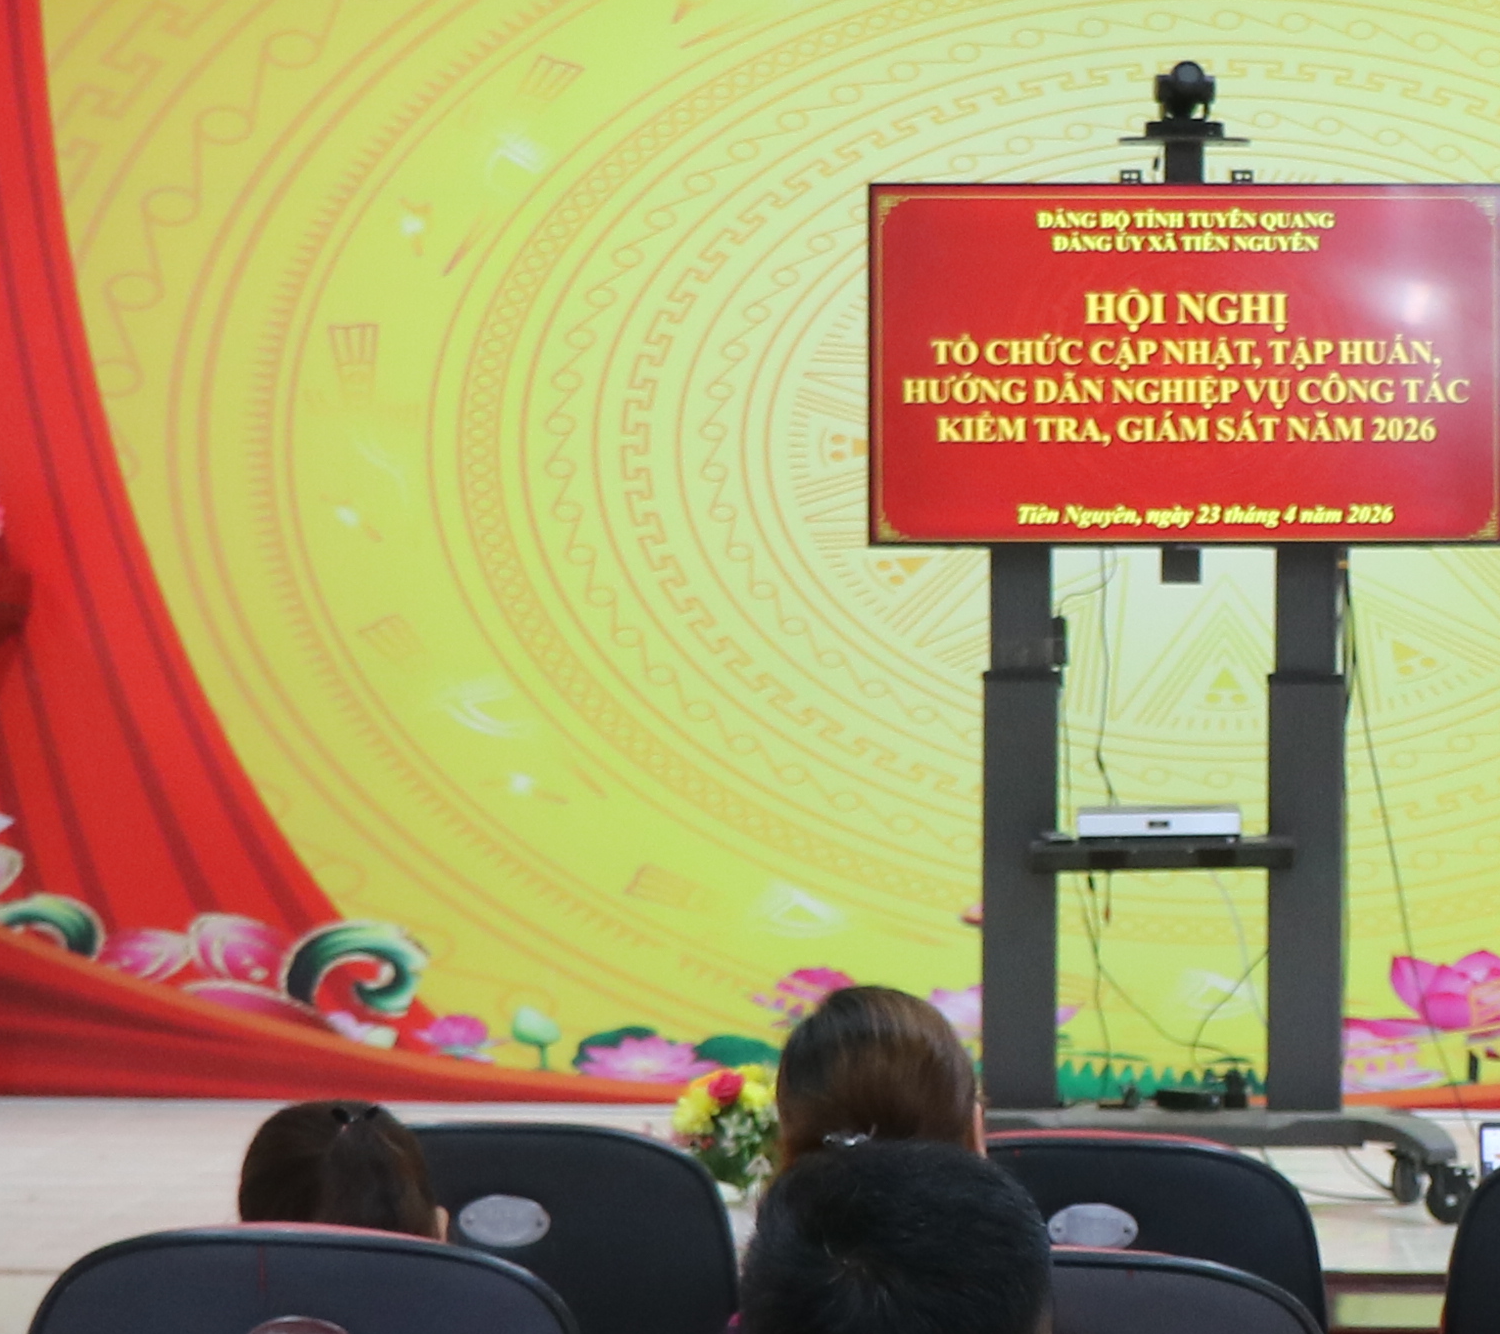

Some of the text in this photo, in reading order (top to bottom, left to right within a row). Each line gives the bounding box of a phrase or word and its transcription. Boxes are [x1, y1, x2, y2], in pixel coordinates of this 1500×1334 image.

[1037, 209, 1335, 231] ĐẢNG BỘ TỈNH TUYÊN QUANG
[1051, 232, 1320, 252] ĐẢNG ỦY XÃ TIÊN NGUYÊN
[1084, 289, 1289, 333] HỘI NGHỊ
[930, 333, 1442, 372] TỔ CHỨC CẬP NHẬT, TẬP HUẤN,
[902, 371, 1471, 410] HƯỚNG DẪN NGHIỆP VỤ CÔNG TÁC
[937, 409, 1437, 446] KIỂM TRA, GIÁM SÁT NĂM 2026
[1017, 504, 1393, 528] Tiên Nguyên, ngày 23 tháng 4 năm 2026
